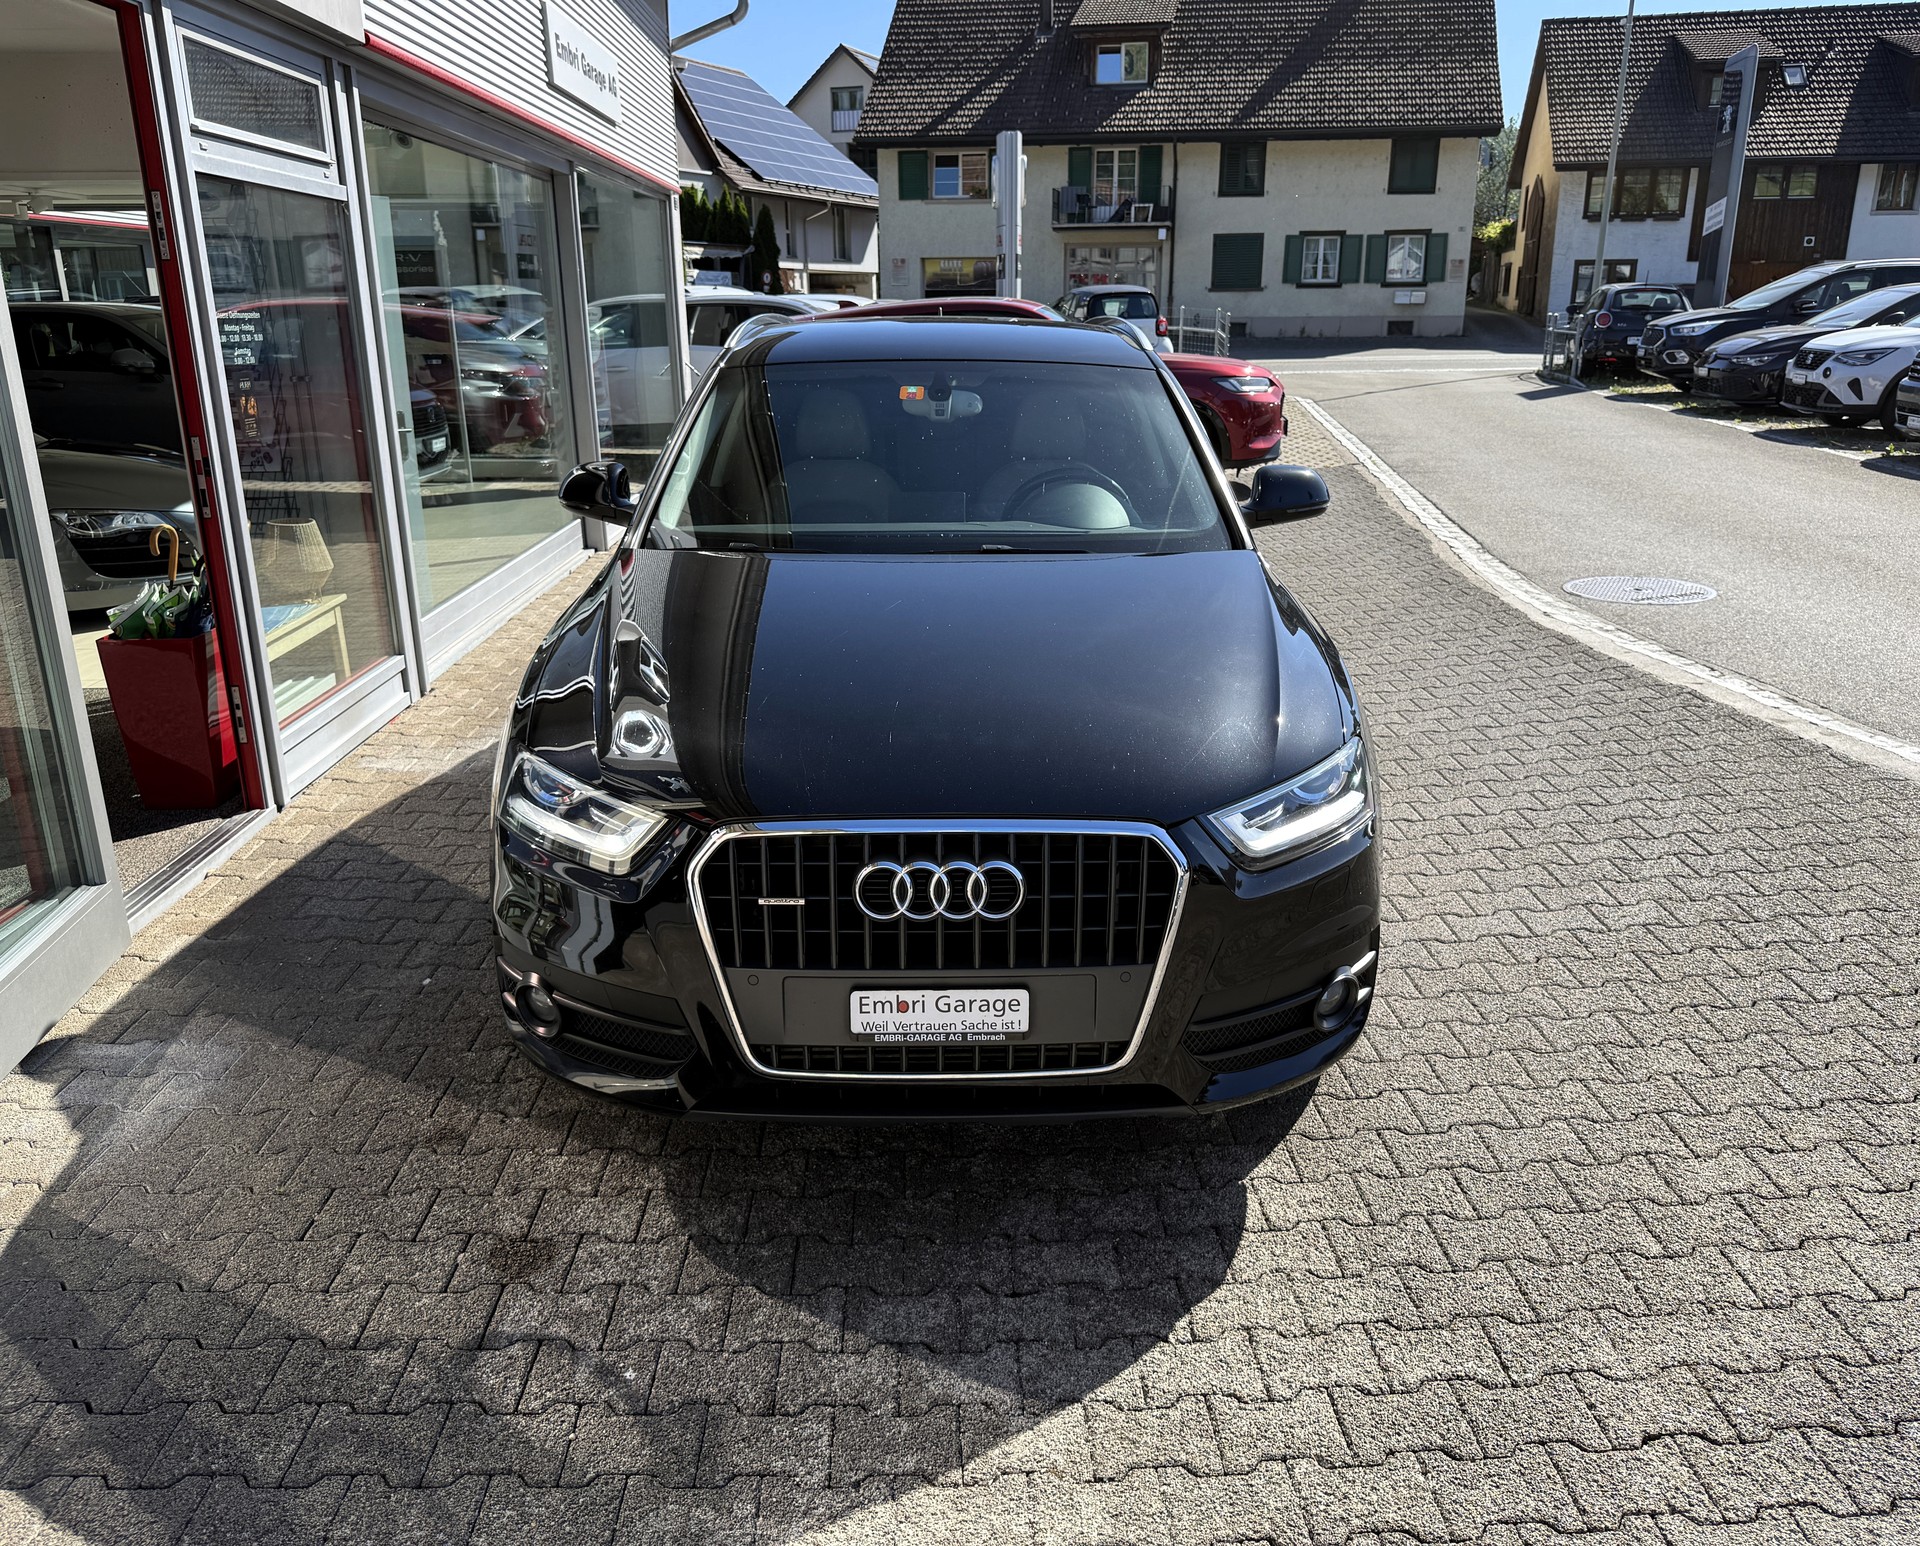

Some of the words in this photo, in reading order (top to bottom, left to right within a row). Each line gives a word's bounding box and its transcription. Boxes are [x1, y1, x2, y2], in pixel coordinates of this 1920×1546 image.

[555, 32, 579, 71] Embri
[581, 52, 606, 92] Garage
[608, 73, 617, 97] AG
[396, 254, 421, 262] R-V
[396, 265, 434, 273] ssories
[224, 324, 239, 333] Montag
[858, 995, 926, 1014] Embri
[935, 995, 1021, 1018] Garage
[861, 1021, 888, 1032] Weil
[893, 1021, 957, 1032] Vertrauen
[961, 1019, 997, 1031] Sache
[1001, 1020, 1015, 1030] ist
[874, 1034, 947, 1042] EMBRI-GARAGE
[948, 1033, 962, 1041] AG
[967, 1033, 1006, 1041] Embrach
